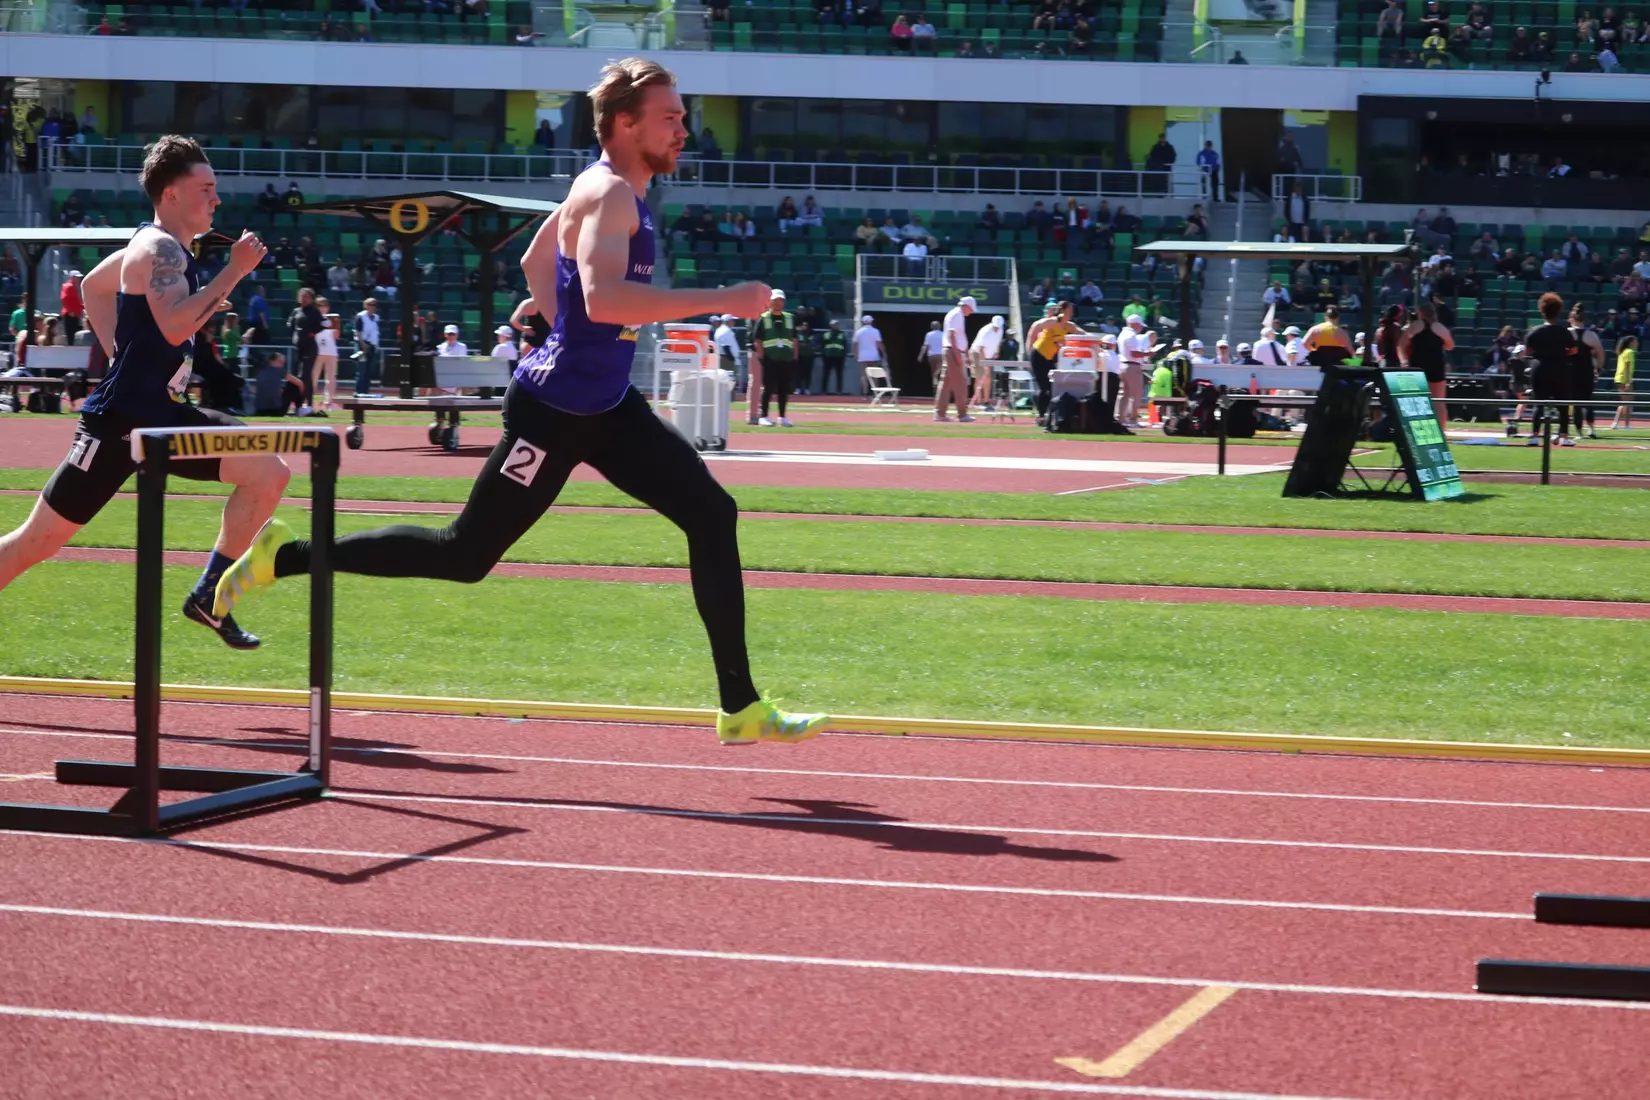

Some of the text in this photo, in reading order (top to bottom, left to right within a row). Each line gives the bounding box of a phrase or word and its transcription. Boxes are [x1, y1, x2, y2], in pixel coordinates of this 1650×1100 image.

[389, 200, 430, 234] O
[883, 286, 989, 301] DUCKS
[213, 435, 269, 451] DUCKS
[505, 446, 536, 481] 2
